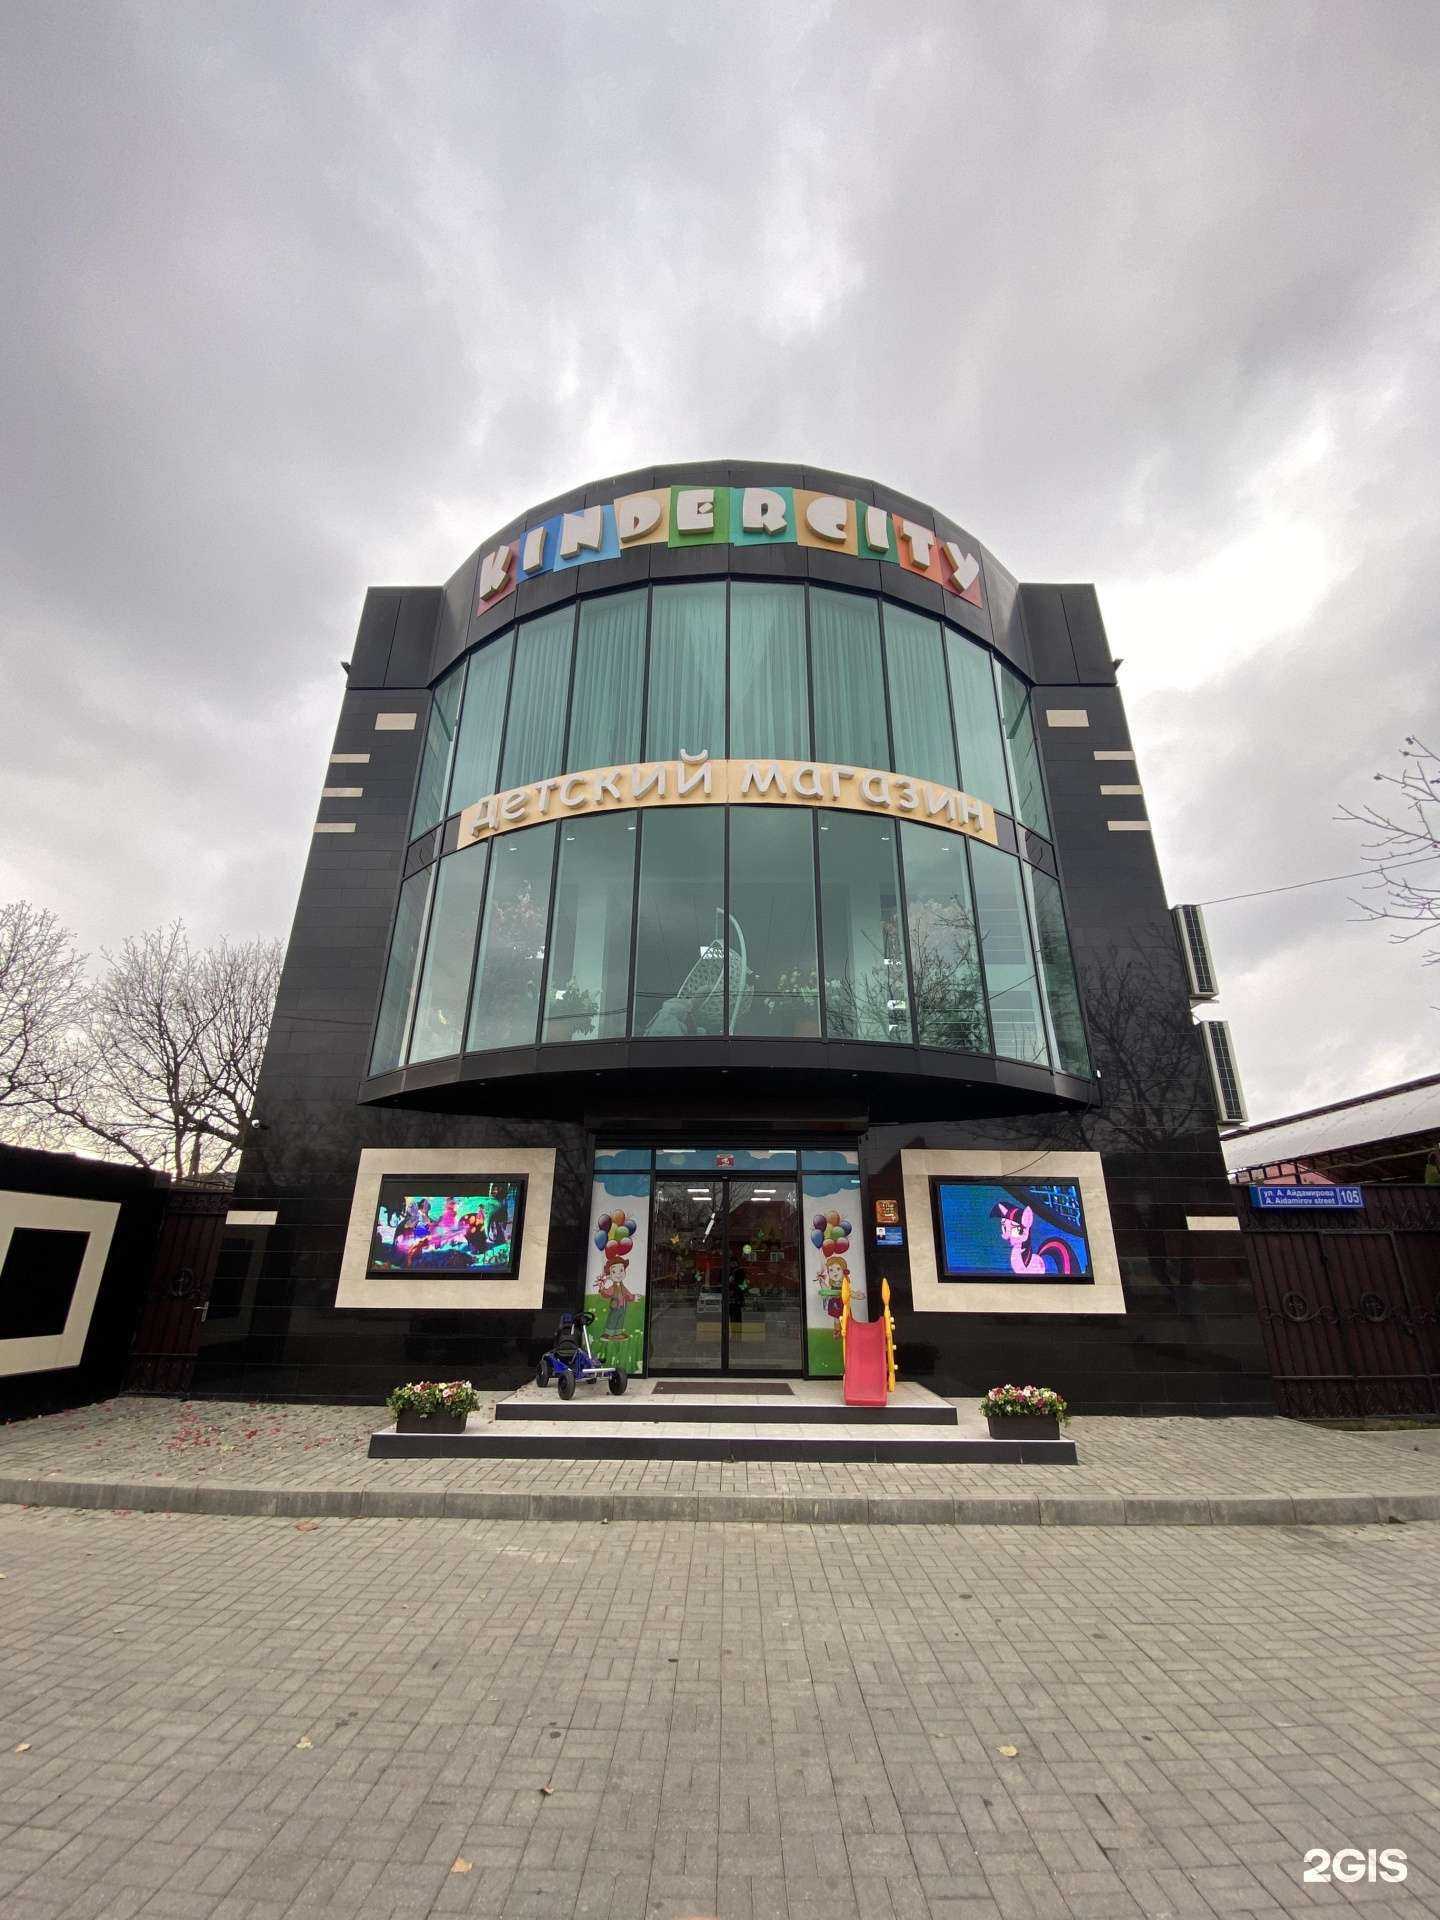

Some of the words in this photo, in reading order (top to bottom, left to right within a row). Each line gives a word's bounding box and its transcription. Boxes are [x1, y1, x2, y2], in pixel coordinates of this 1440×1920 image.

[741, 763, 983, 833] магазин
[1314, 1197, 1336, 1205] street
[1341, 1190, 1360, 1204] 105
